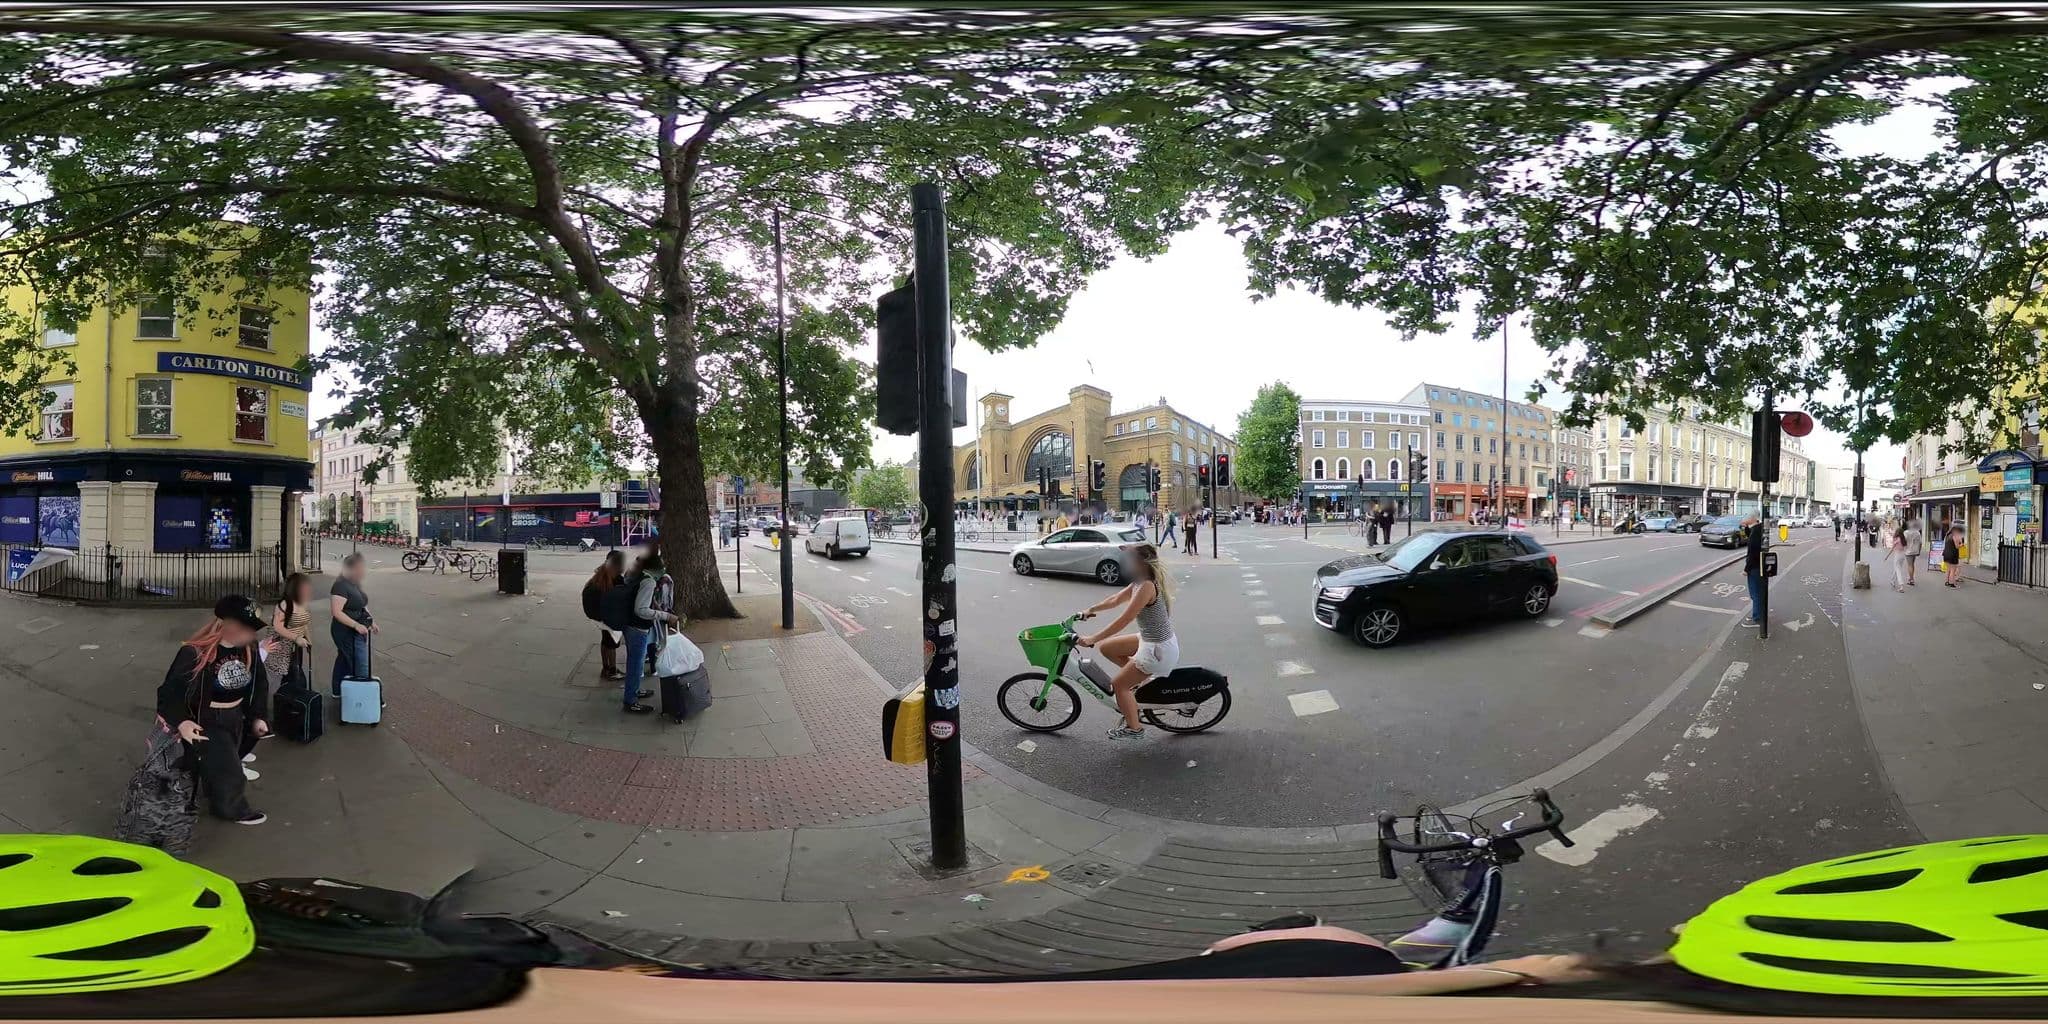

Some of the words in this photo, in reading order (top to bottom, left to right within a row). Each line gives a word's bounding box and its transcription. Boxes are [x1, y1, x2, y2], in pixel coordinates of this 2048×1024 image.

[171, 355, 249, 374] CARLTON
[255, 365, 302, 385] HOTEL
[38, 472, 54, 481] HILL
[213, 472, 232, 481] HILL
[19, 516, 30, 524] HILL
[183, 520, 196, 528] HILL
[1173, 686, 1190, 694] Lime
